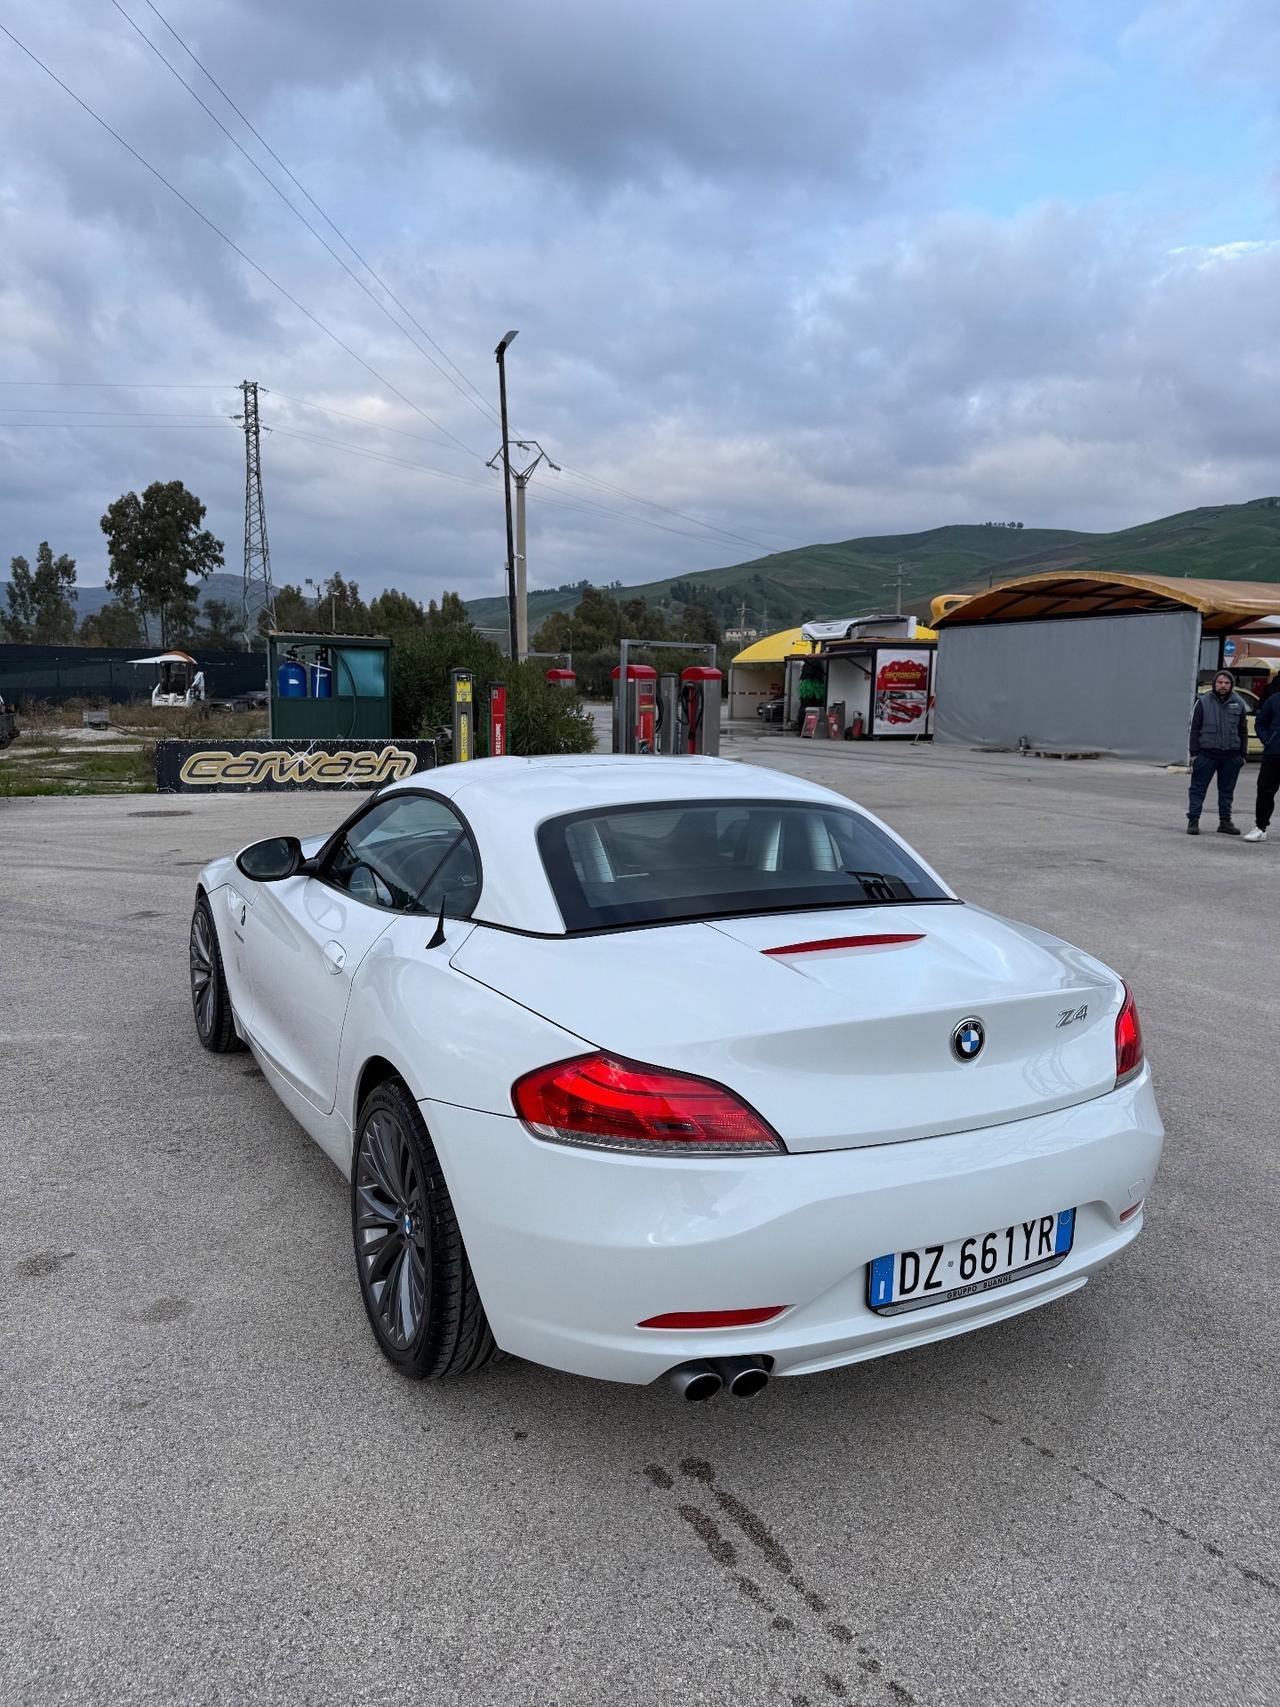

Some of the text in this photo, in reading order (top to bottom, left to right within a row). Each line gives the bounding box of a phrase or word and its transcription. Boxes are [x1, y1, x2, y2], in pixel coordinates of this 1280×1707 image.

[1056, 1002, 1089, 1028] Z4
[899, 1214, 1055, 1295] DZ 661YR
[946, 1275, 1013, 1299] GRUPPO BUANNE
